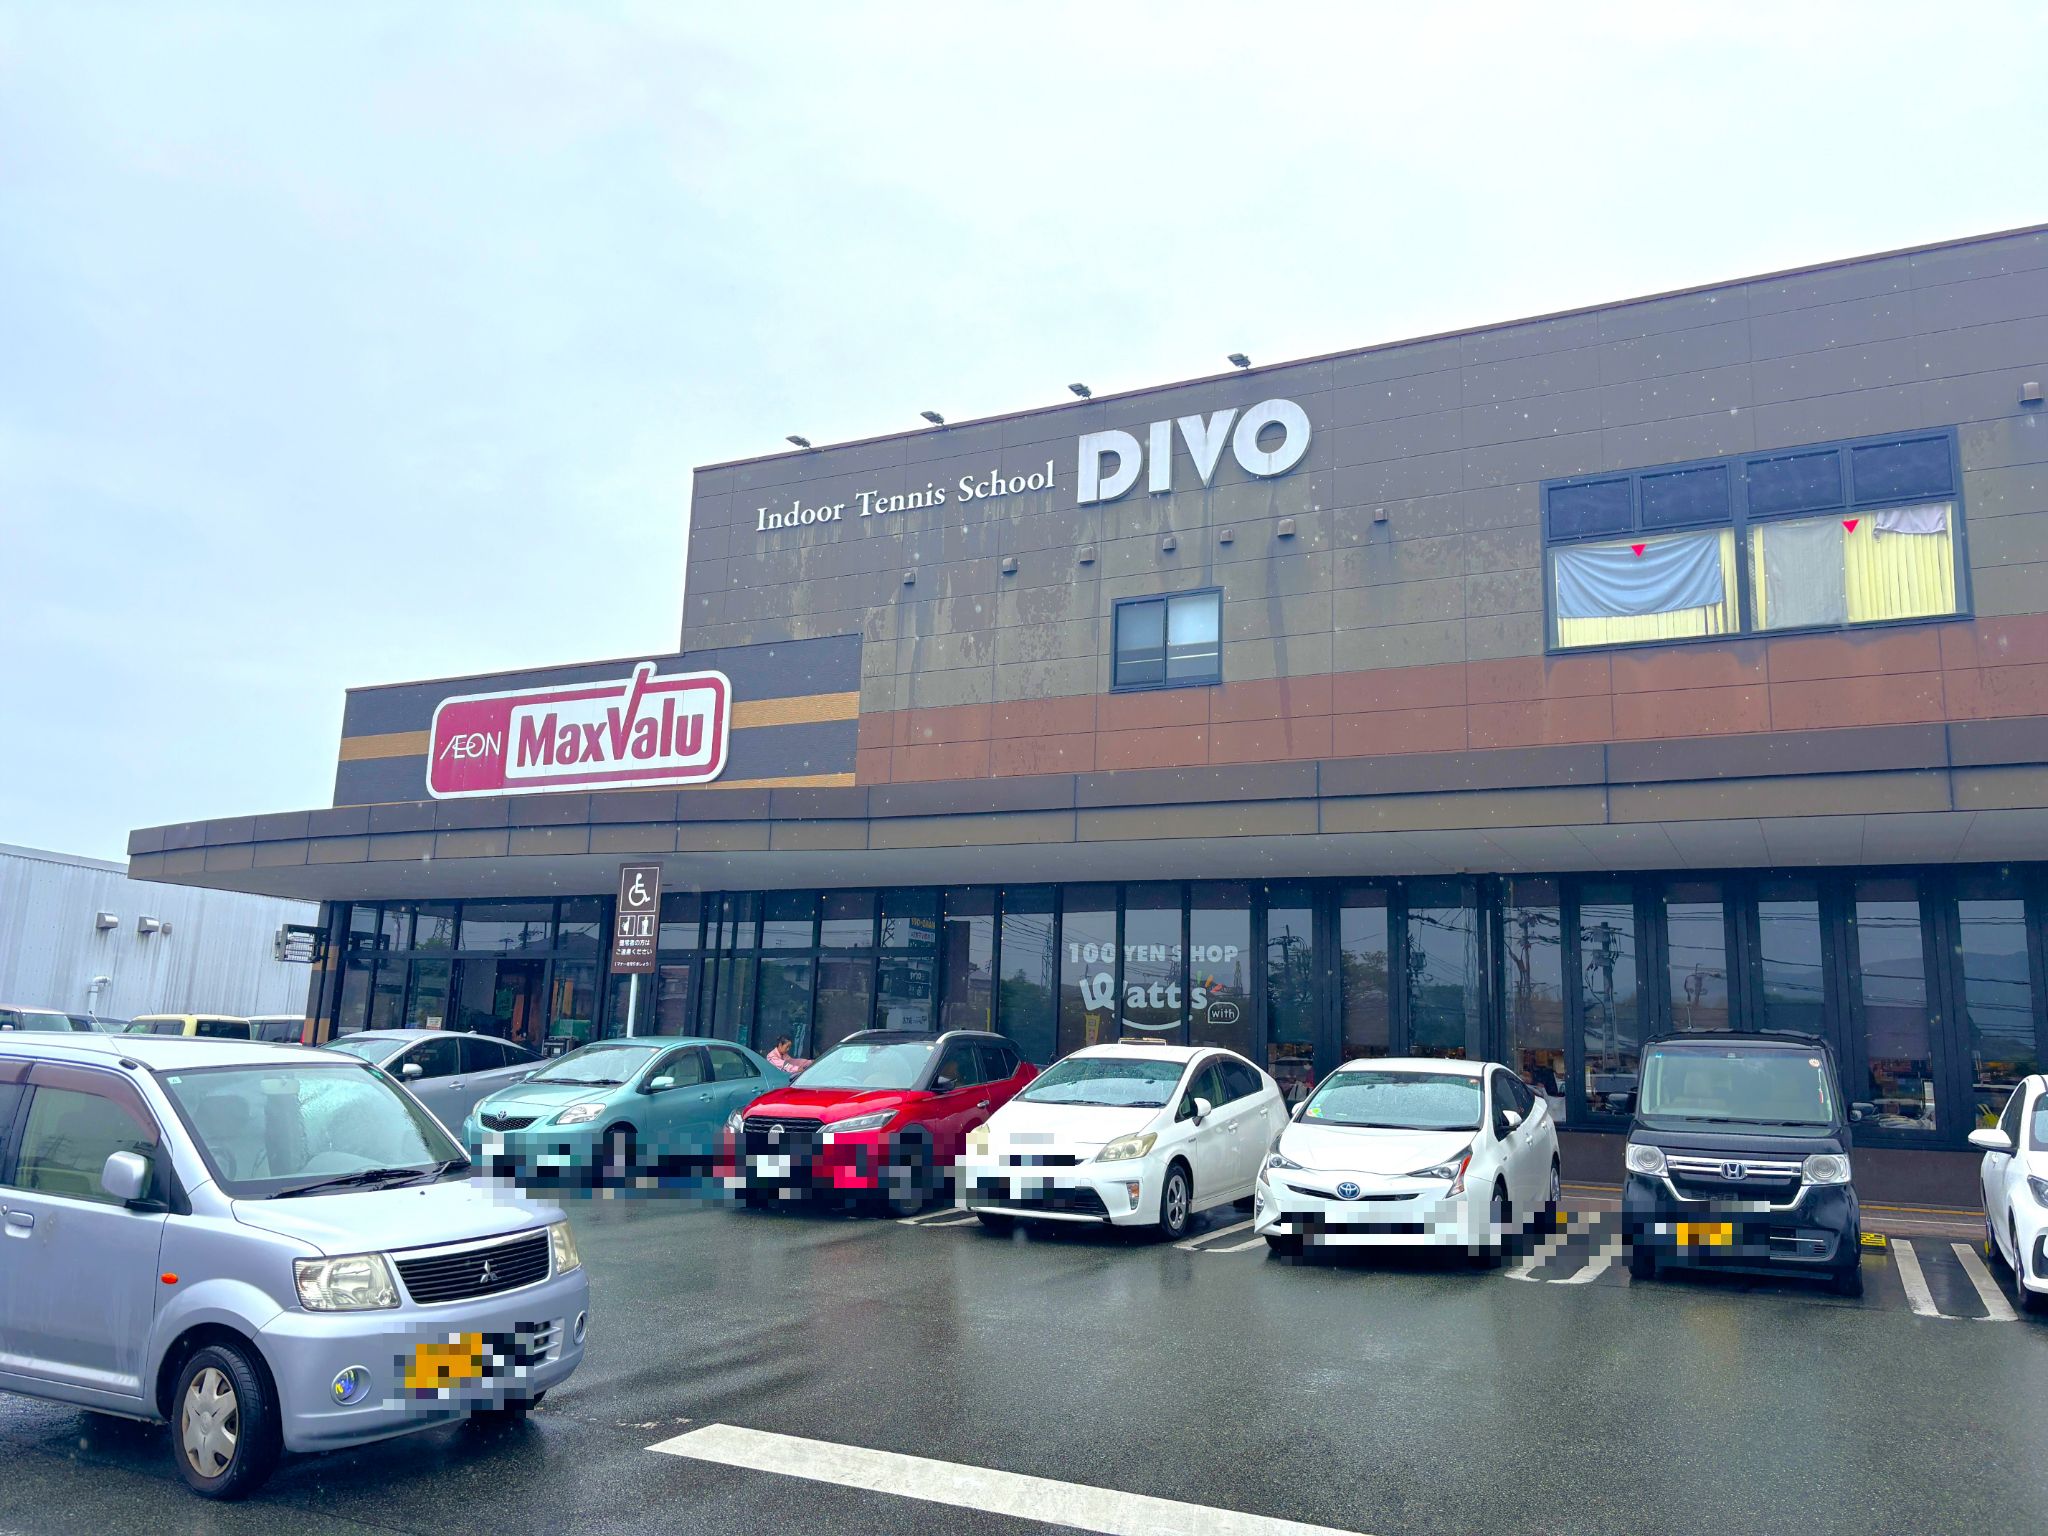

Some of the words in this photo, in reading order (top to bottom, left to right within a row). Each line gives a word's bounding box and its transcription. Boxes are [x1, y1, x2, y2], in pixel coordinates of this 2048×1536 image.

[756, 501, 843, 532] Indoor
[855, 482, 945, 519] Tennis
[958, 460, 1056, 503] School
[1077, 398, 1313, 505] DIVO
[516, 667, 704, 768] MaxValu
[1069, 942, 1116, 963] 100
[1123, 945, 1166, 962] YEN
[1171, 944, 1239, 963] SHOP
[1211, 1007, 1235, 1019] with
